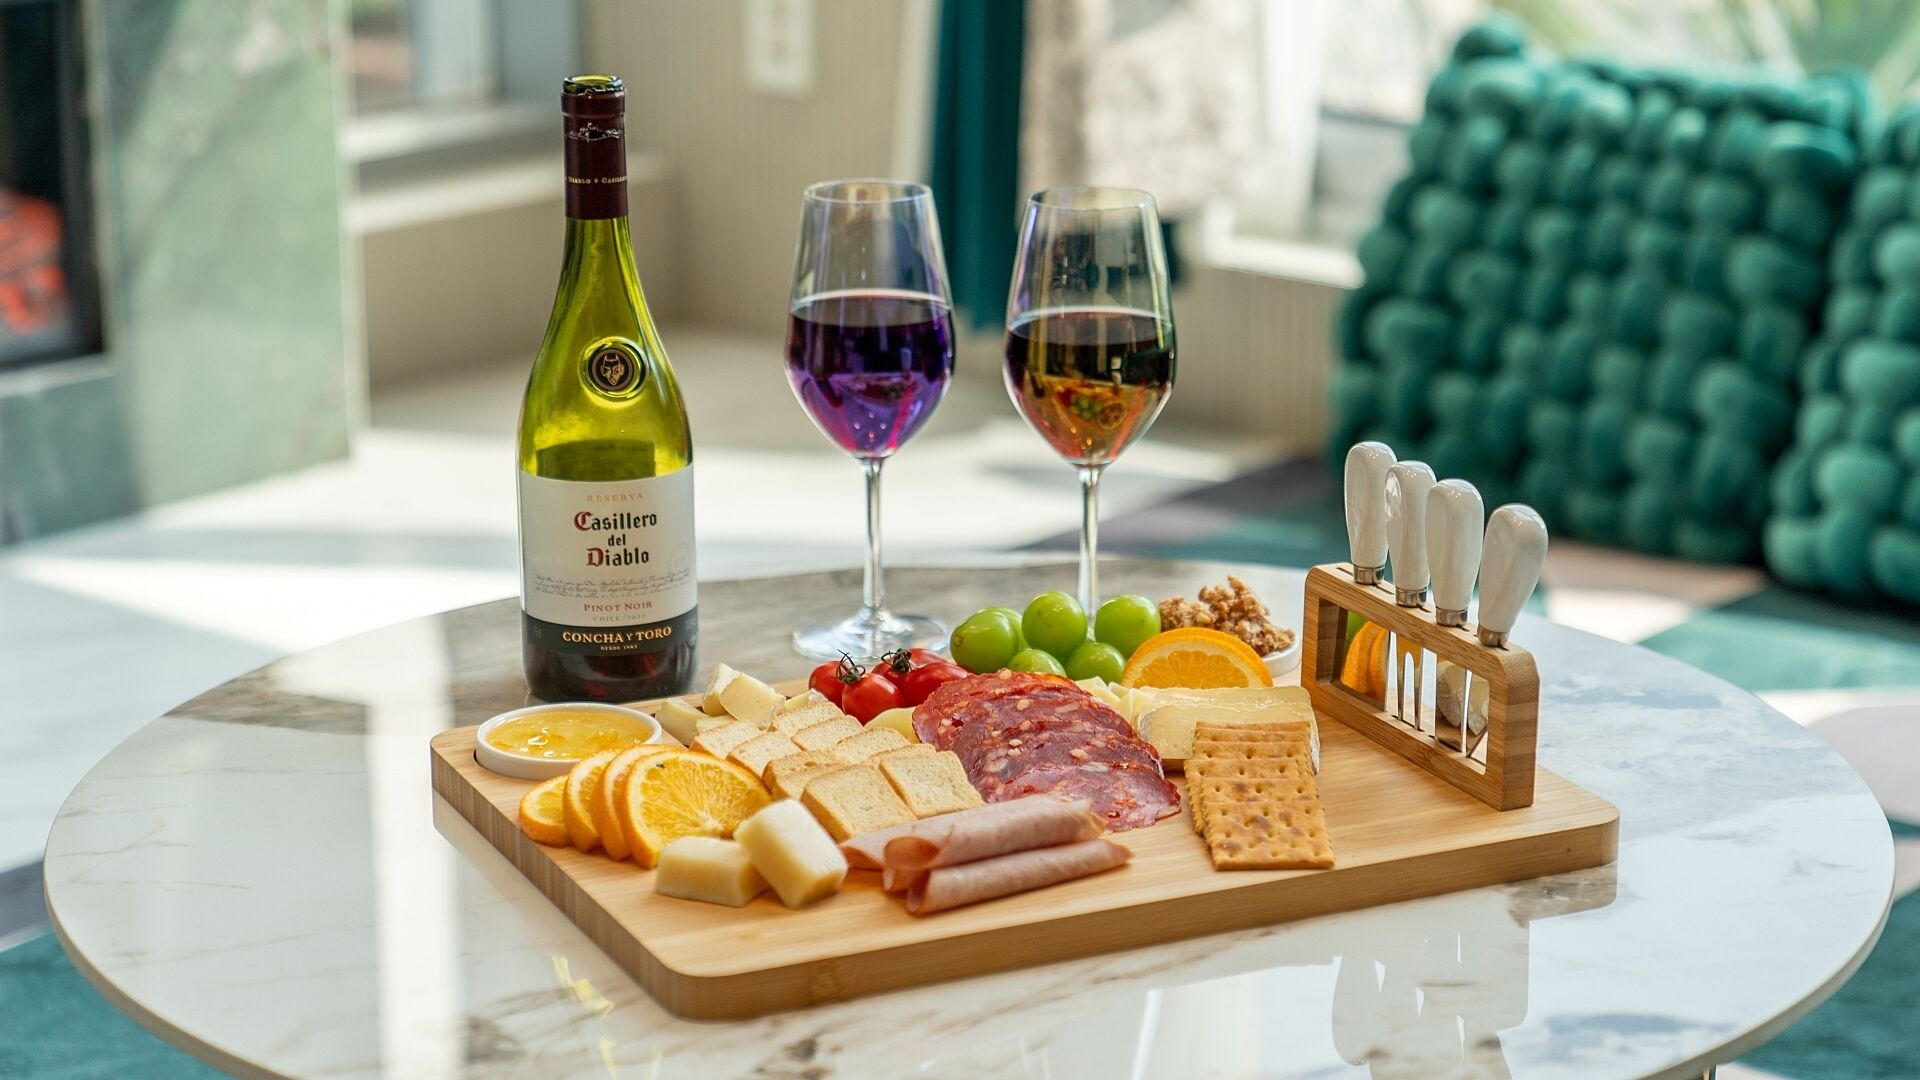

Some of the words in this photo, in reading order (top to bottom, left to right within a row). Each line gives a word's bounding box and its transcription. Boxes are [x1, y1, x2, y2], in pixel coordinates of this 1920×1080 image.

[586, 492, 644, 502] RESERVA
[573, 511, 657, 532] Casillero
[607, 533, 626, 547] del
[586, 547, 649, 567] Diablo
[583, 603, 621, 612] PINOT
[624, 601, 653, 611] NOIR
[562, 631, 624, 644] CONCHA
[635, 626, 672, 641] TORO
